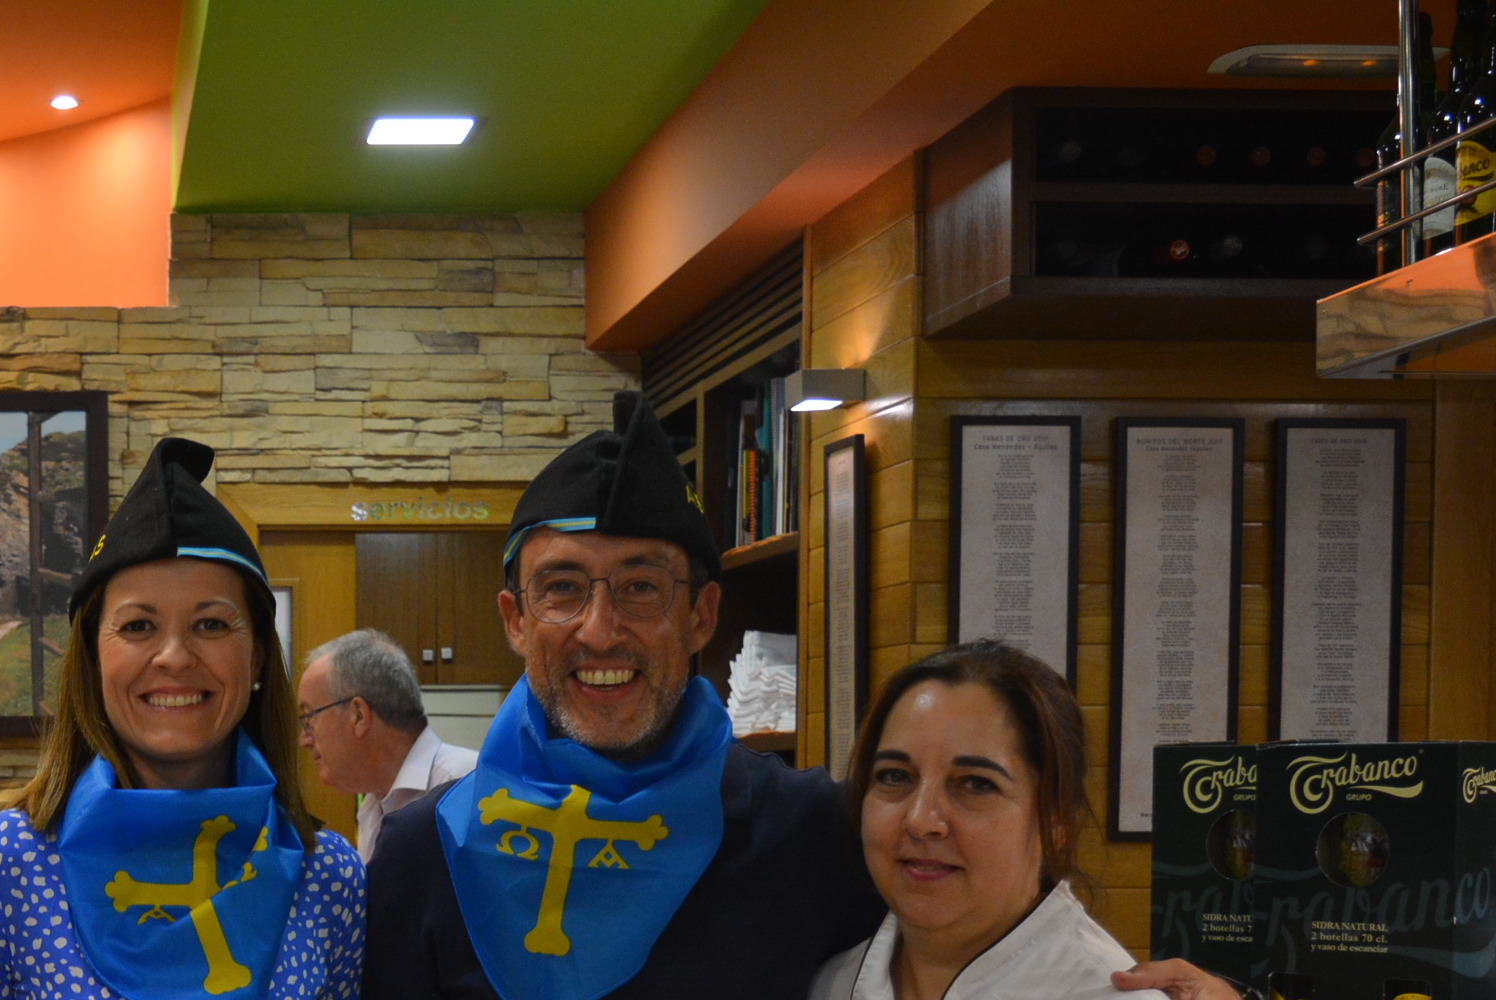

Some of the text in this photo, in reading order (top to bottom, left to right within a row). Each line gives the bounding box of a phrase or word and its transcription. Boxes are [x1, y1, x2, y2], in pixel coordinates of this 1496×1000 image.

[351, 496, 489, 521] servicios
[1286, 751, 1418, 814] Trabanco
[1345, 793, 1372, 801] GRUPO
[1202, 913, 1228, 922] SIDRA
[1209, 923, 1244, 933] botellas
[1311, 920, 1388, 932] SIDRA NATURAL
[1311, 931, 1317, 940] 2
[1319, 931, 1358, 942] botellas
[1361, 933, 1373, 943] 70
[1317, 943, 1336, 952] vaso
[1337, 942, 1347, 952] de
[1349, 944, 1389, 954] escanciar
